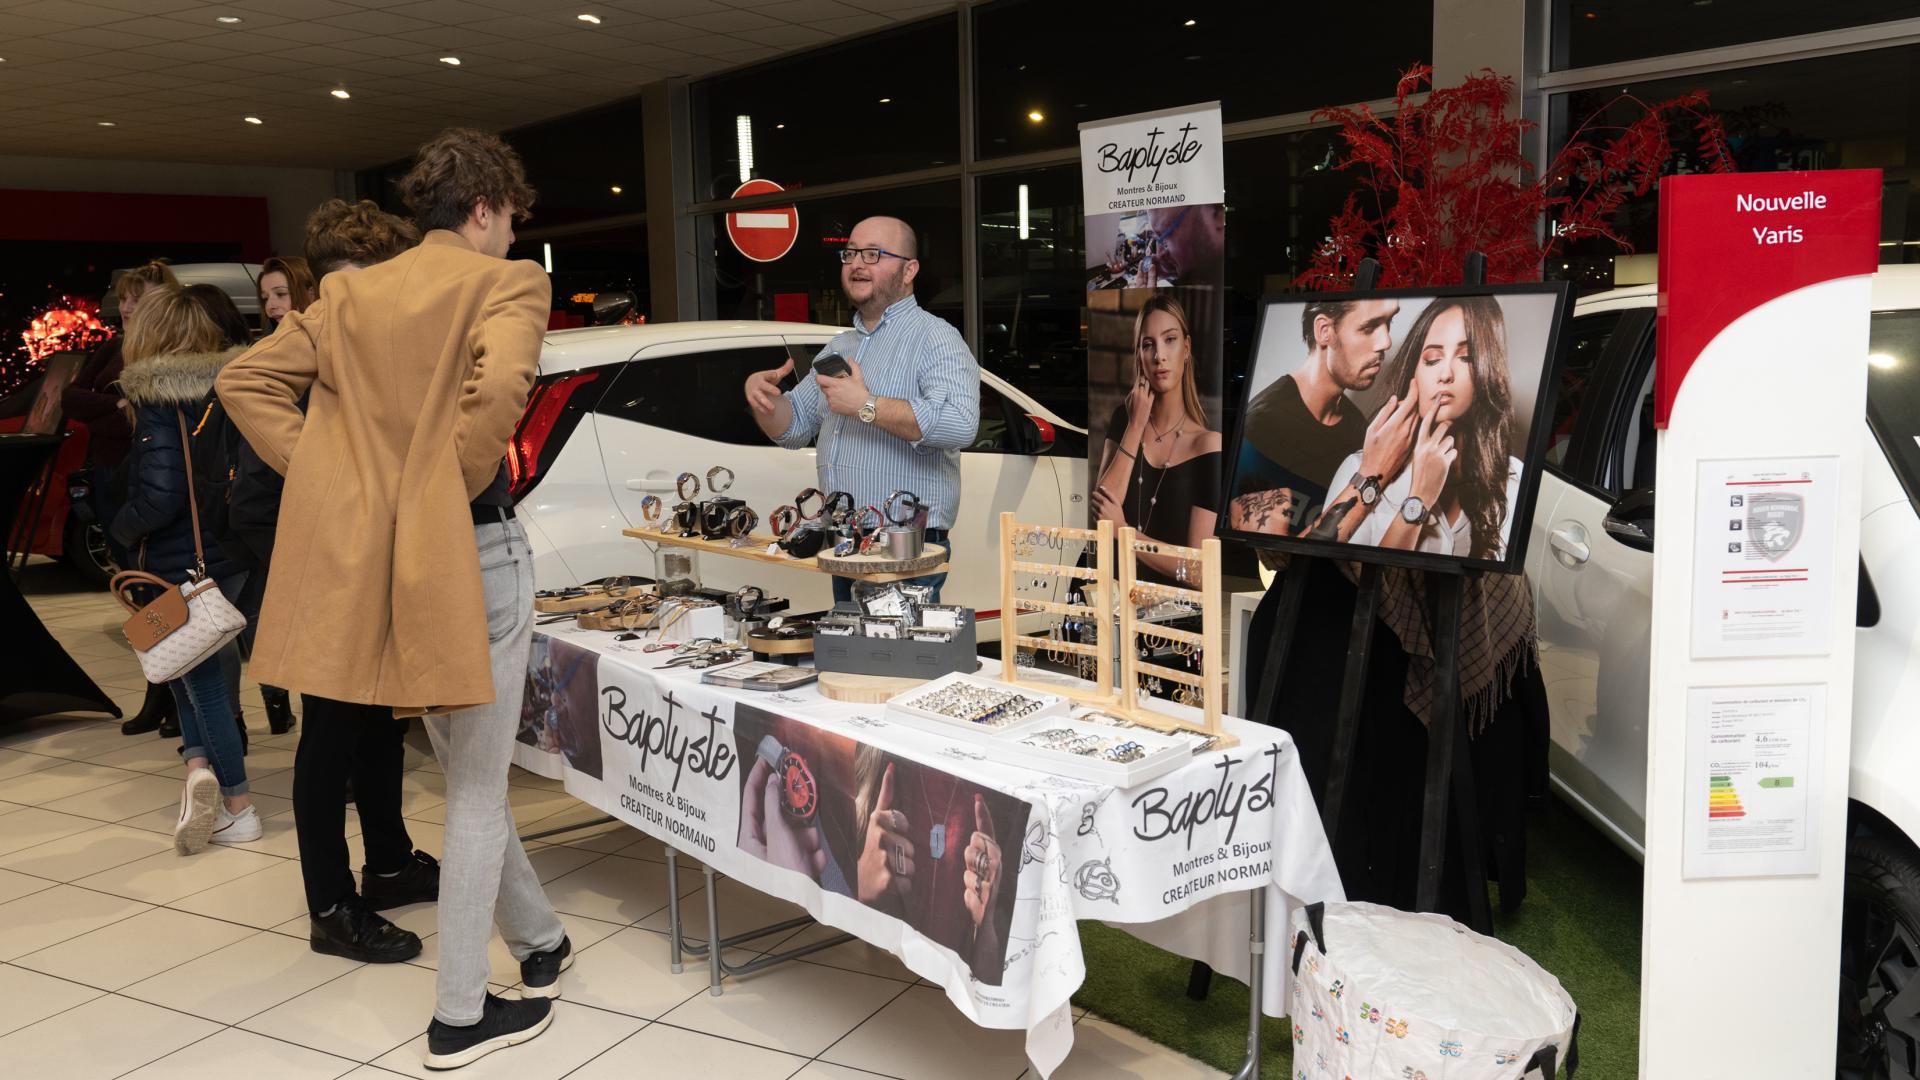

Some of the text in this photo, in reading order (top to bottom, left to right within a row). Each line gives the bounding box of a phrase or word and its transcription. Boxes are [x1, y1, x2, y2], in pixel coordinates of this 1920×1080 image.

[1097, 122, 1203, 183] Baptyste
[1108, 194, 1186, 210] CREATEUR NORMAND
[1117, 182, 1178, 196] Montres & Bijoux
[1736, 191, 1827, 212] Nouvelle
[1752, 225, 1804, 245] Yaris
[601, 685, 737, 793] Baptyste
[629, 774, 706, 822] Montres & Bijoux
[1131, 742, 1283, 852] Baptyst
[620, 793, 716, 853] CREATEUR NORMAND
[1173, 840, 1272, 877] Montres & Bijoux
[1162, 859, 1273, 905] CREATEUR NORMA
